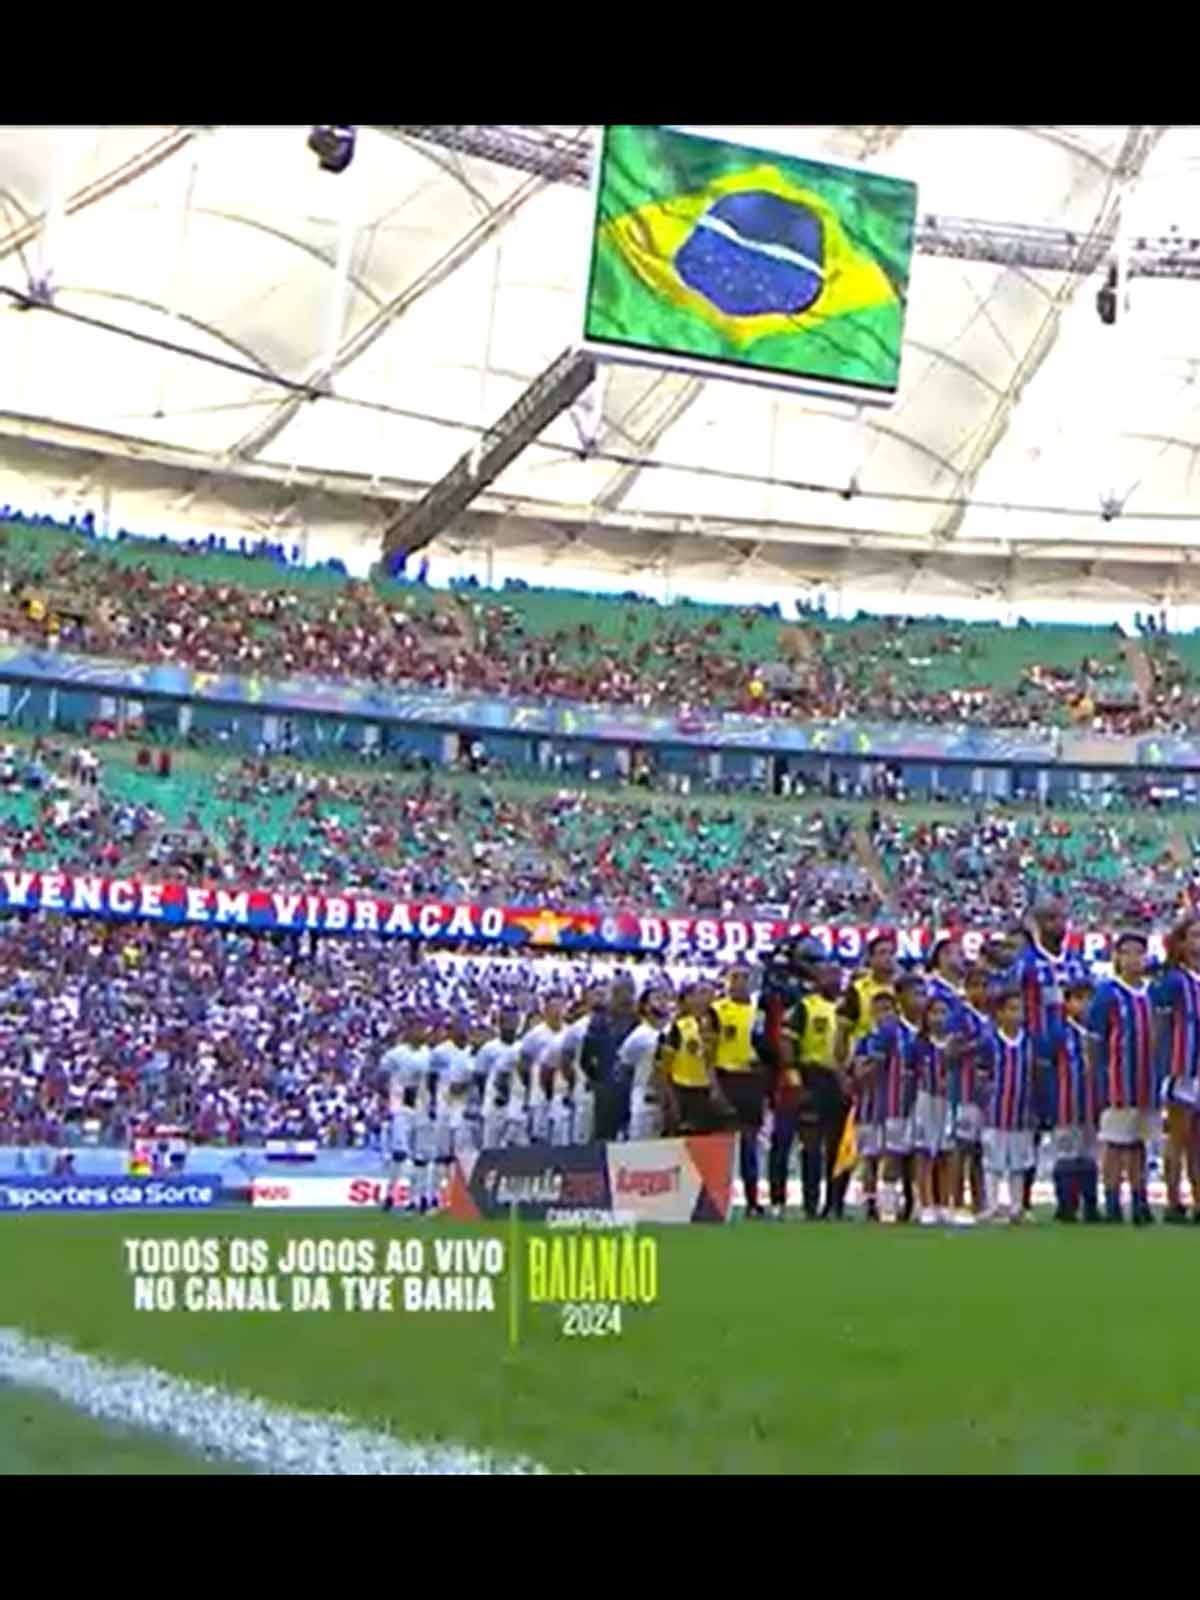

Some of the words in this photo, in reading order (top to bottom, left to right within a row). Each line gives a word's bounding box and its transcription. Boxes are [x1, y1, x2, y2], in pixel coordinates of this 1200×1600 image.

[4, 871, 164, 917] VENCE
[186, 884, 249, 924] EM
[640, 918, 775, 952] DESDE
[111, 1186, 142, 1206] da
[145, 1184, 213, 1206] Sorte
